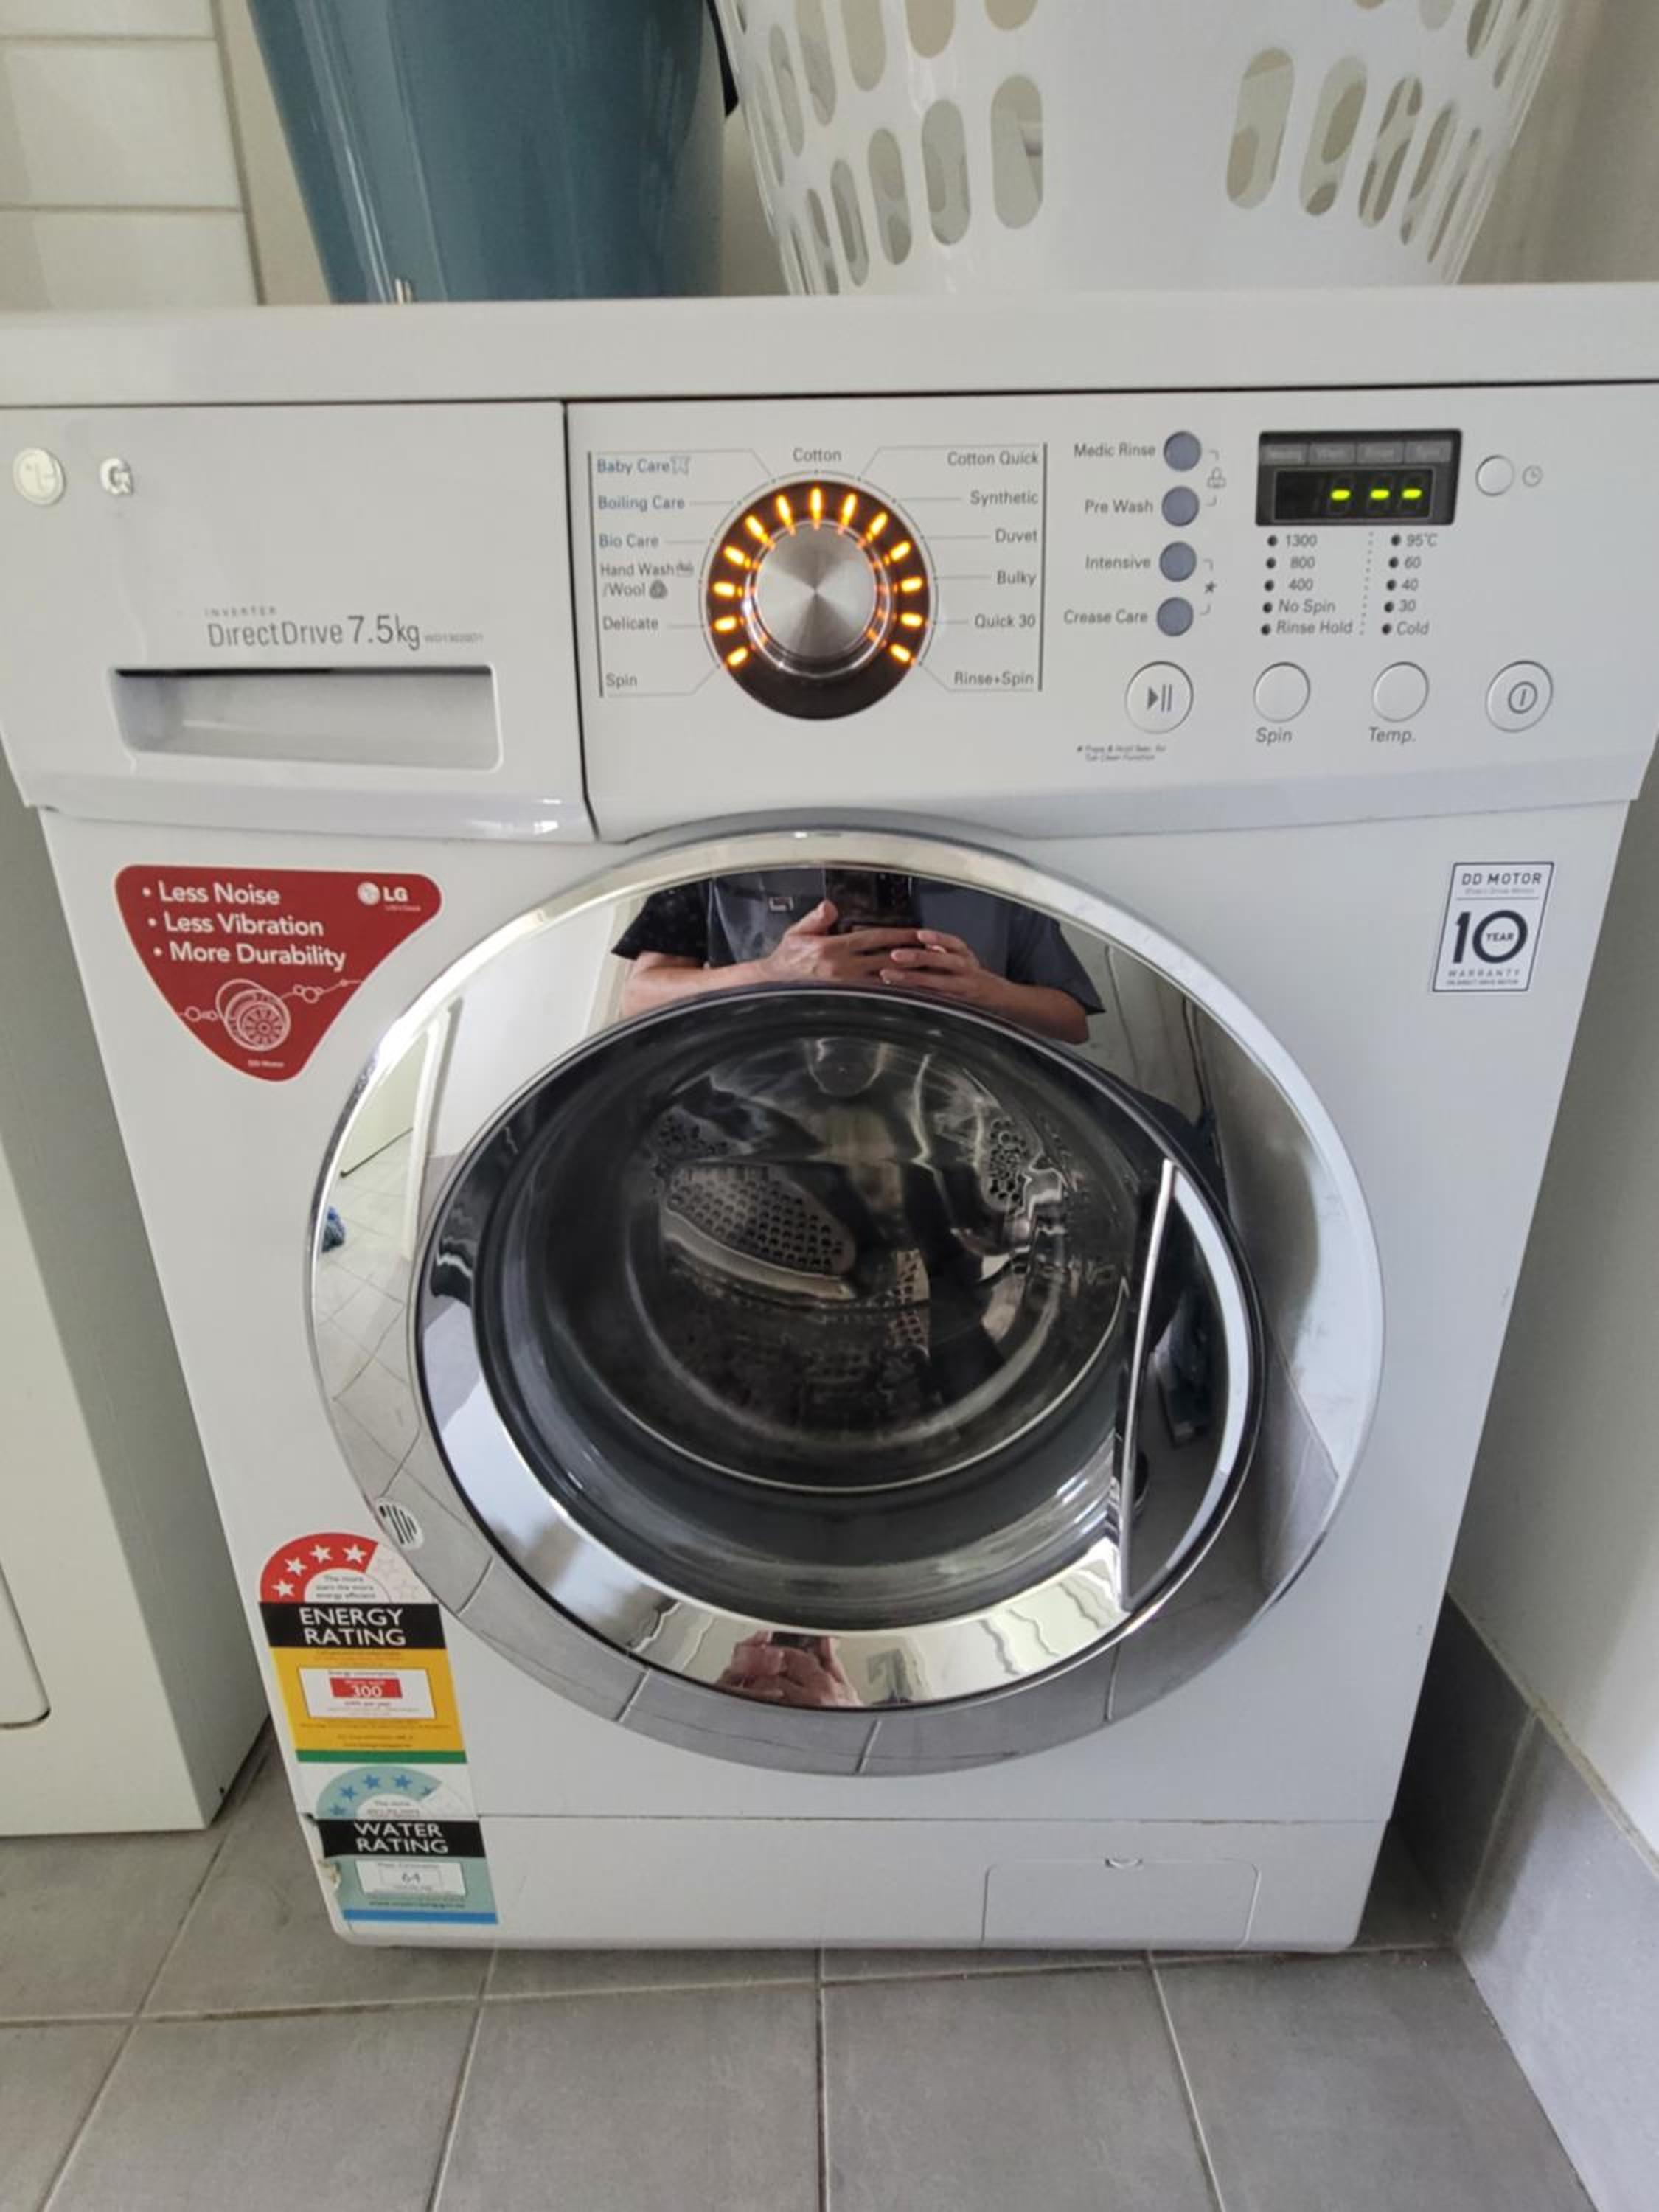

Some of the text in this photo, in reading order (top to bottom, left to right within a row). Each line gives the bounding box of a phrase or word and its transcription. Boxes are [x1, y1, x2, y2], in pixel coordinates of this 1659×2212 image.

[793, 448, 841, 462] Cotton
[1074, 442, 1155, 457] Medic Rinse
[947, 451, 1039, 466] Cotton Quick
[597, 459, 670, 475] Baby Care
[598, 495, 684, 512] Boiling Care
[970, 490, 1038, 507] Synthetic
[1085, 499, 1153, 514] Pre Wash
[599, 535, 658, 548] Bio Care
[995, 529, 1037, 543] Duvet
[1286, 534, 1318, 546] 1300
[1085, 554, 1151, 569] Intensive
[1290, 557, 1315, 569] 800
[1405, 557, 1422, 569] 60
[601, 563, 675, 577] Hand Wash
[997, 571, 1037, 587] Bulky
[1288, 579, 1313, 591] 400
[1402, 579, 1419, 591] 40
[1279, 599, 1335, 616] No Spin
[1399, 600, 1416, 612] 30
[603, 616, 658, 630] Delicate
[975, 614, 1036, 628] Quick 30
[1063, 609, 1148, 624] Crease Care
[1276, 621, 1353, 635] Rinse Hold
[1397, 622, 1429, 635] Cold
[606, 674, 638, 689] Spin
[1256, 727, 1293, 744] Spin
[1369, 728, 1416, 744] Temp.
[1461, 872, 1542, 885] DD MOTOR
[159, 881, 281, 906] Less Noise
[383, 886, 409, 902] LG
[164, 911, 324, 937] Less Vibration
[1453, 909, 1528, 964] 10
[1486, 932, 1514, 942] YEAR
[170, 942, 347, 972] More Durability
[299, 1607, 403, 1626] ENERGY
[303, 1628, 406, 1646] RATING
[354, 1823, 442, 1838] WATER
[356, 1838, 448, 1854] RATING
